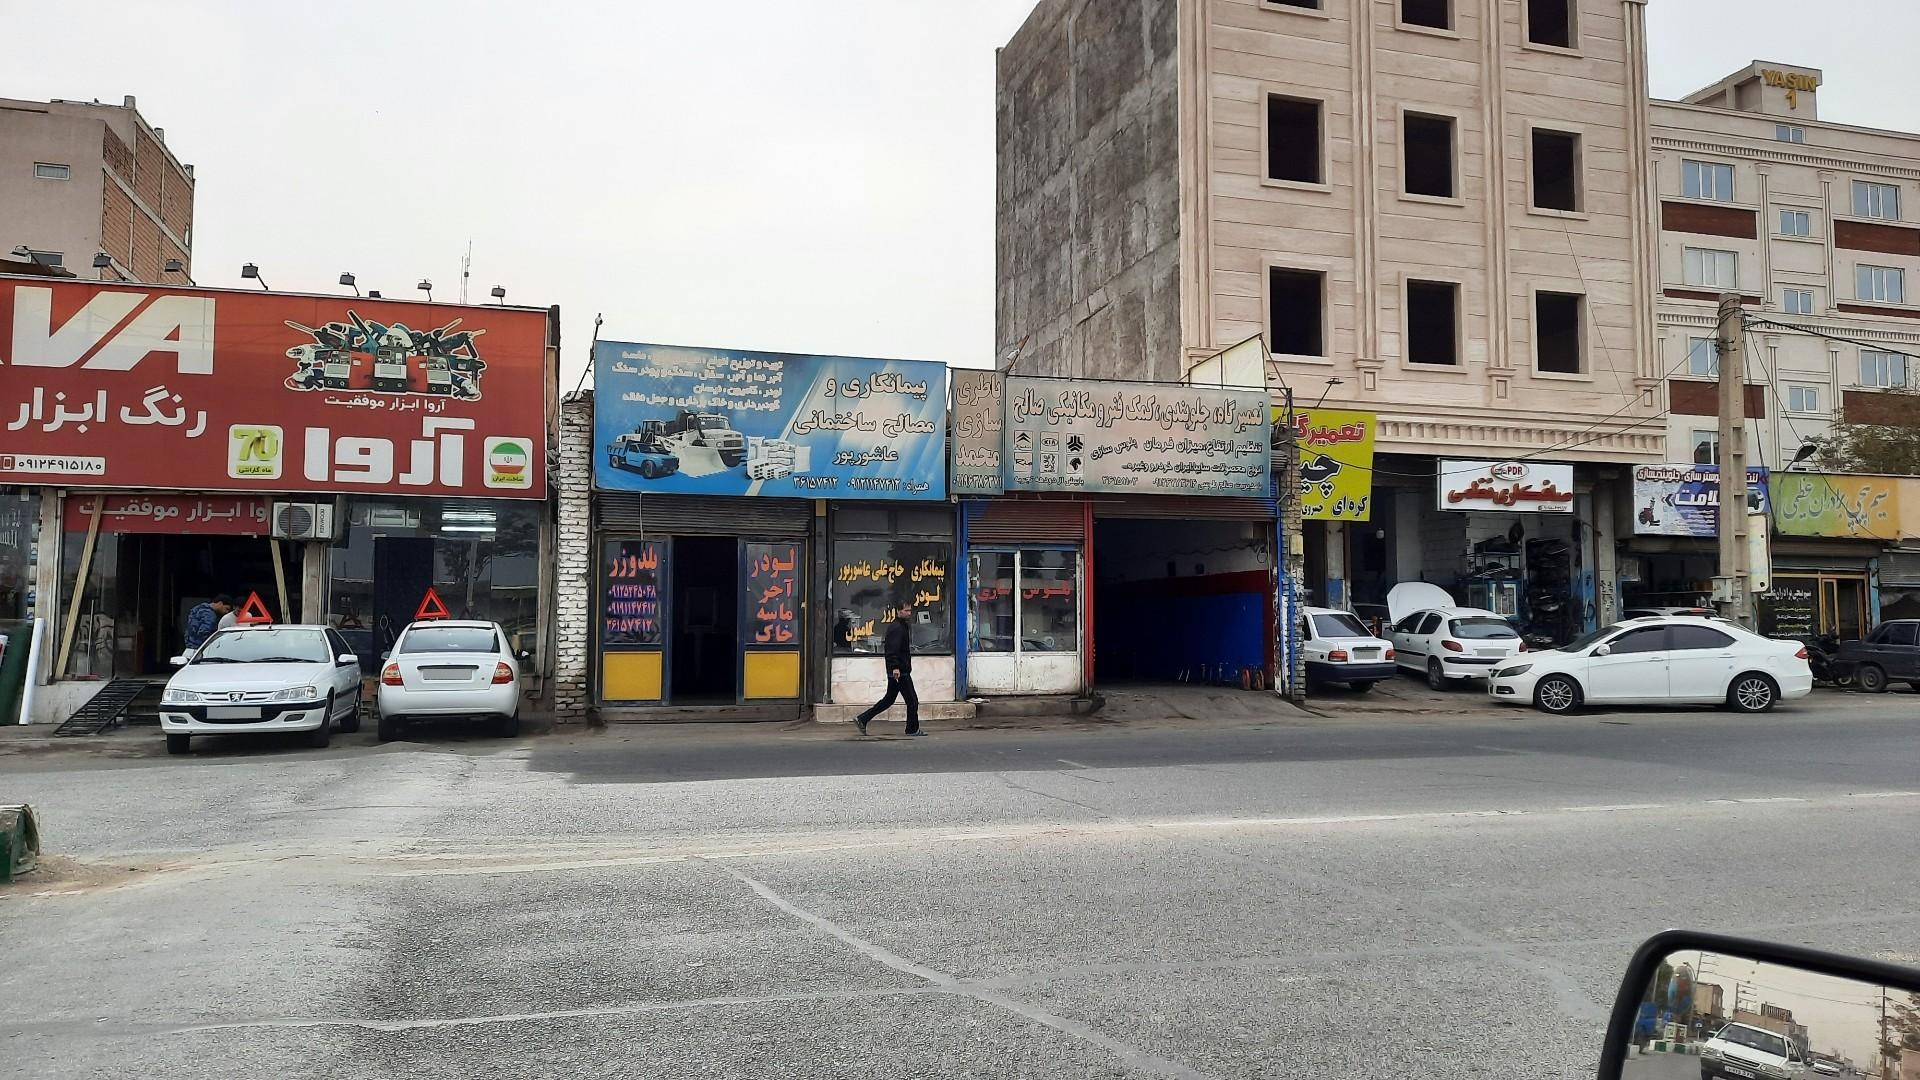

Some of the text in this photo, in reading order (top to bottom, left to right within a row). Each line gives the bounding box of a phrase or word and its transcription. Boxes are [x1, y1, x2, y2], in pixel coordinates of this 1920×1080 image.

[1761, 69, 1817, 92] YASIN
[1785, 89, 1797, 110] 1
[824, 372, 927, 400] پیمانکاری و
[956, 373, 1002, 406] باطری
[7, 385, 207, 438] رنگ ابزار
[325, 396, 446, 413] آروا ابزار موفقیت
[1013, 387, 1045, 424] صالح
[1047, 391, 1097, 425] مکانیکی
[1096, 404, 1105, 427] و
[1105, 392, 1124, 428] فنر
[1126, 395, 1156, 421] کمک
[793, 410, 936, 438] مصالح ساختمانی
[955, 407, 1002, 438] سازی
[234, 428, 279, 462] 70
[304, 416, 475, 487] آروا
[955, 443, 1000, 467] محمد
[1090, 445, 1113, 460] سازی
[1143, 437, 1174, 452] فرمان
[1234, 441, 1263, 458] تنظیم
[18, 458, 102, 471] ۰۹۱۲۴۹۱۵۱۸۰
[1507, 466, 1523, 475] PDR
[1674, 489, 1720, 506] لامت
[186, 502, 241, 522] ابزار
[608, 544, 658, 578] بلدوزر
[751, 547, 795, 578] لودر
[871, 560, 888, 581] علی
[911, 559, 945, 582] پیمانکاری
[759, 578, 794, 604] آجر
[913, 585, 940, 606] لودر
[756, 602, 793, 621] ماسه
[755, 624, 793, 642] خاک
[845, 620, 875, 642] کامیون
